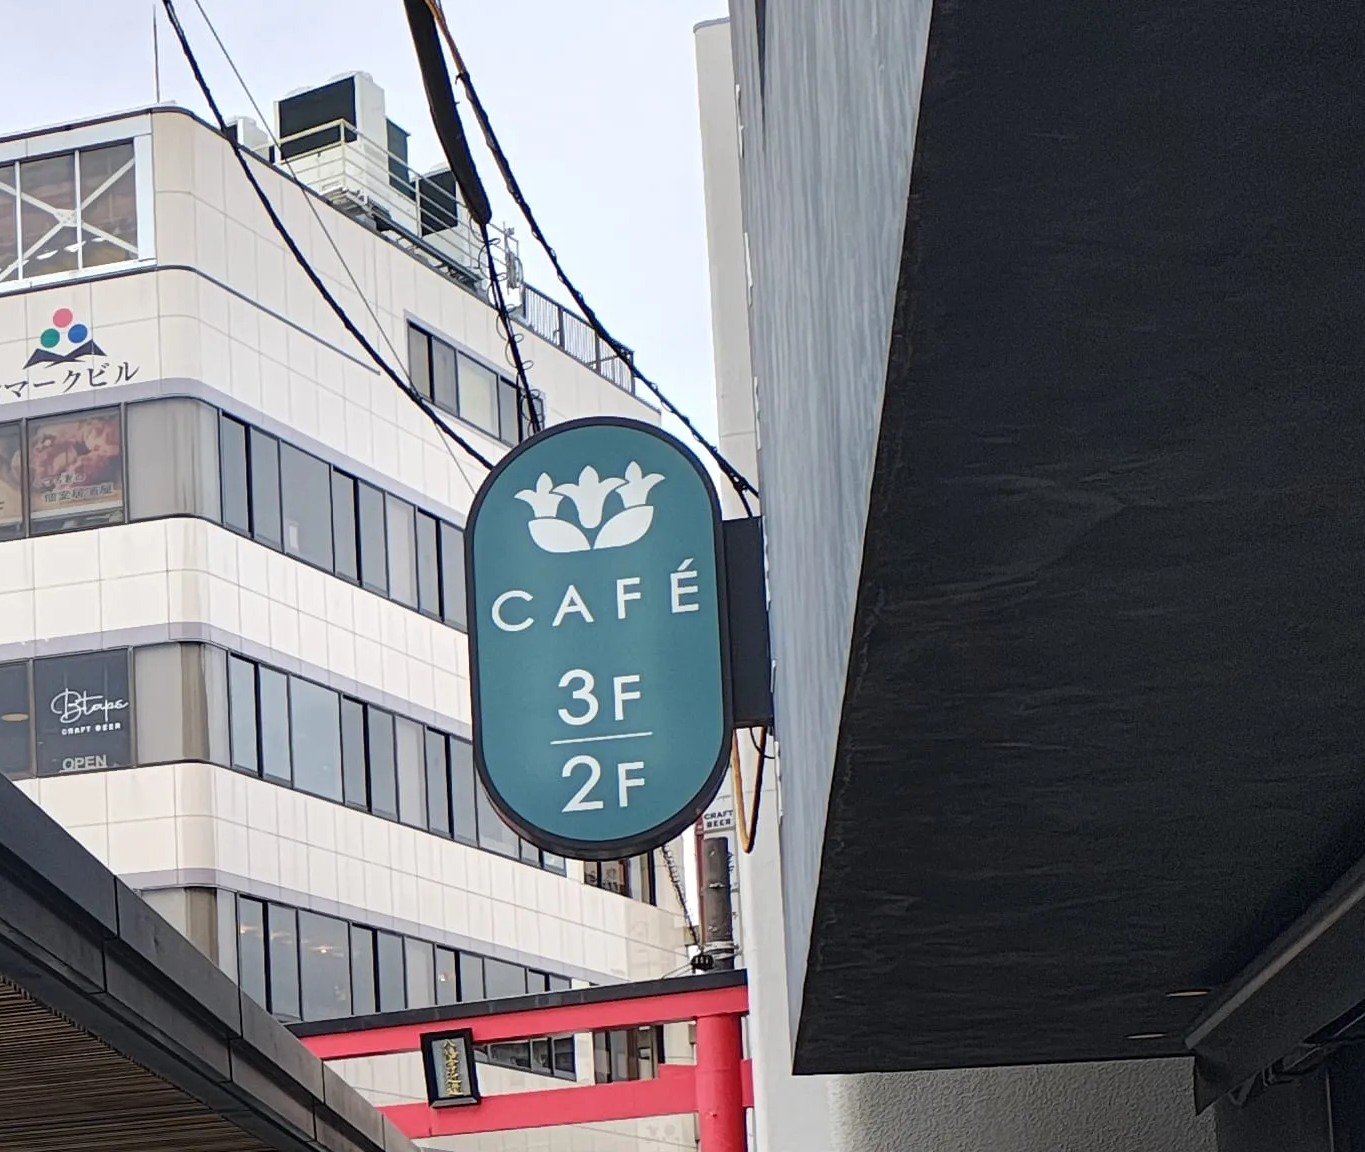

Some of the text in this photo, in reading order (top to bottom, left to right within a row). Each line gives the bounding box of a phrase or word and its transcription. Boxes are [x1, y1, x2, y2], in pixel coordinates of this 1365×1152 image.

[491, 557, 700, 632] CAFÉ
[557, 668, 642, 726] 3F
[61, 722, 121, 736] CRAFT BEER
[62, 754, 107, 771] OPEN
[561, 755, 646, 813] 2F
[703, 809, 734, 820] CRAFT
[706, 818, 731, 828] BEER
